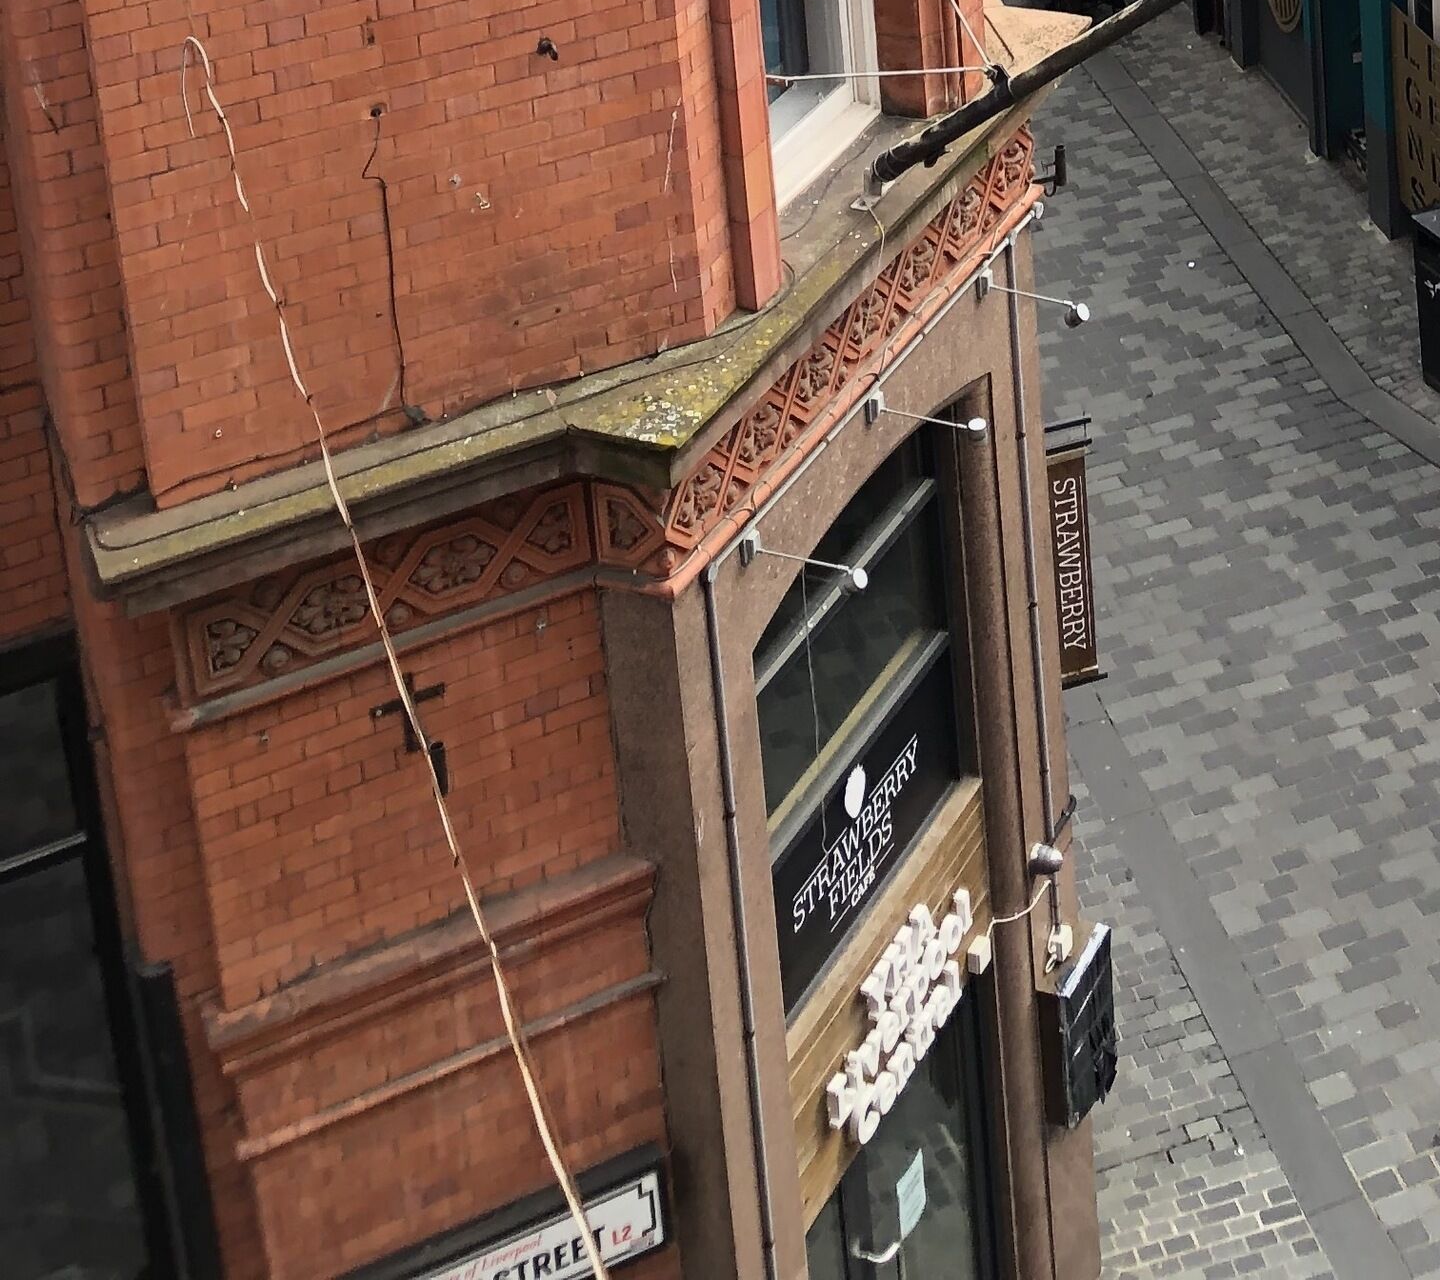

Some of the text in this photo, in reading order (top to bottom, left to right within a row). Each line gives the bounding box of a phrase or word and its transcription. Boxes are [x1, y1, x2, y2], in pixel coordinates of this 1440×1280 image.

[1053, 476, 1087, 651] STRAWBERRY
[793, 739, 919, 933] STRAWBERRY
[829, 810, 894, 921] FIELDS
[826, 887, 974, 1130] Liverpool
[860, 903, 937, 1023] YHA
[852, 959, 963, 1145] Central
[482, 1235, 542, 1271] Liverpool
[611, 1224, 633, 1246] L2
